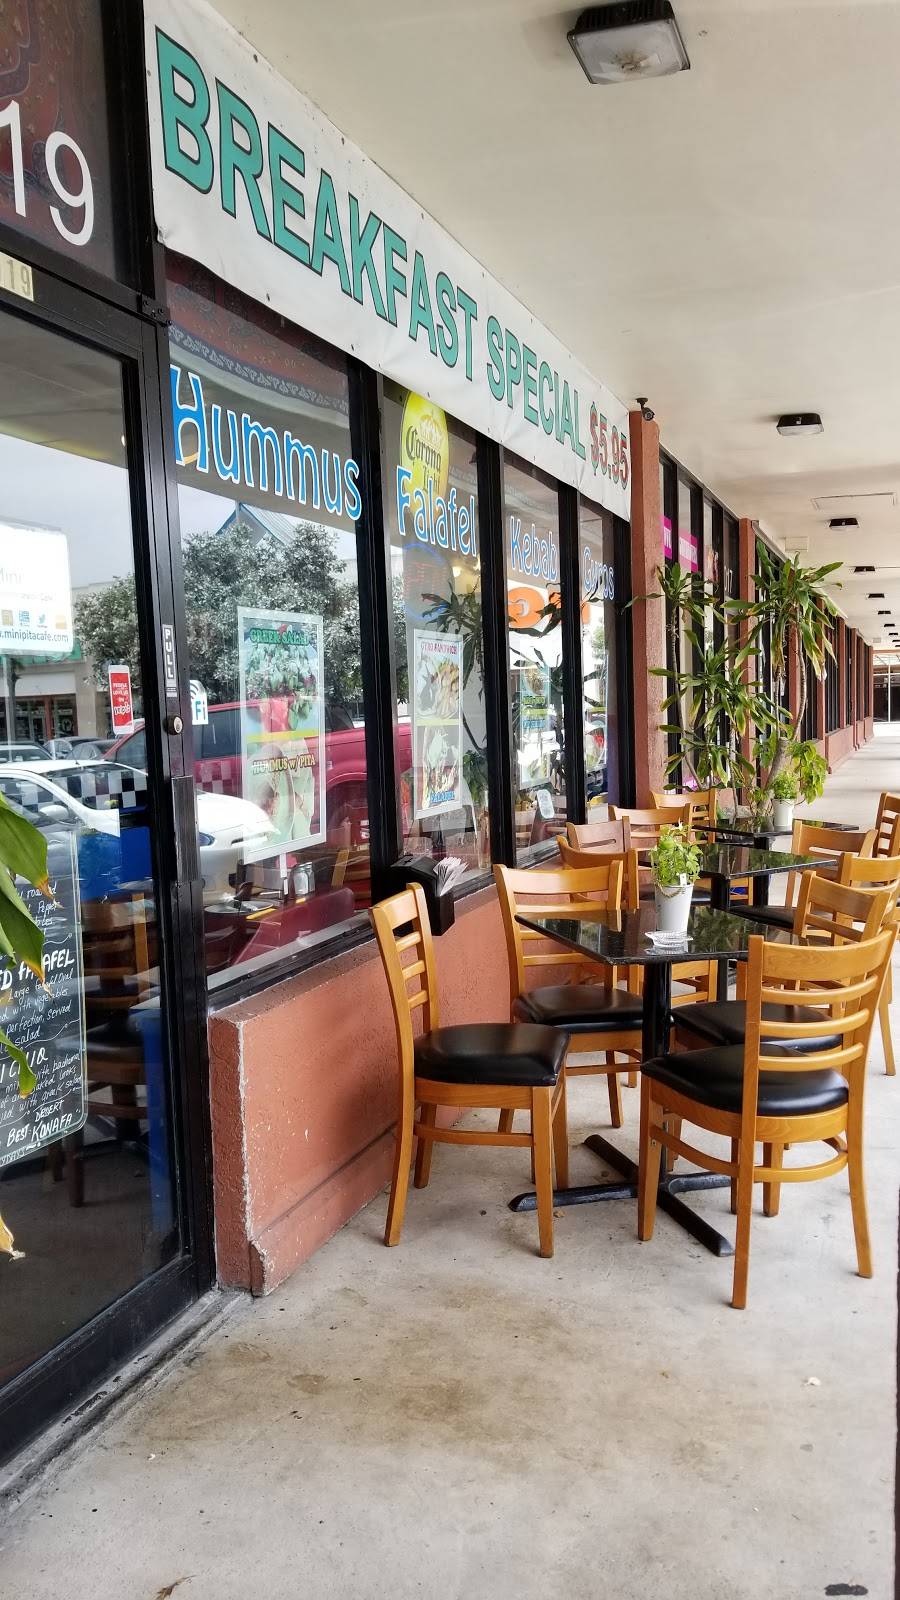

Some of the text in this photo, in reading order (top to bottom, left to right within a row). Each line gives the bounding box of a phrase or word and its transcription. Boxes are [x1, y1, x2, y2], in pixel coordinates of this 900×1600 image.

[155, 25, 628, 490] BREAKFAST SPECIAL $5.95
[170, 364, 362, 520] Hummus
[405, 425, 442, 474] Corona
[396, 465, 477, 557] Falafel
[511, 516, 557, 582] Kebab
[583, 546, 615, 600] Gyros
[164, 628, 174, 678] PULL
[300, 753, 316, 768] PITA
